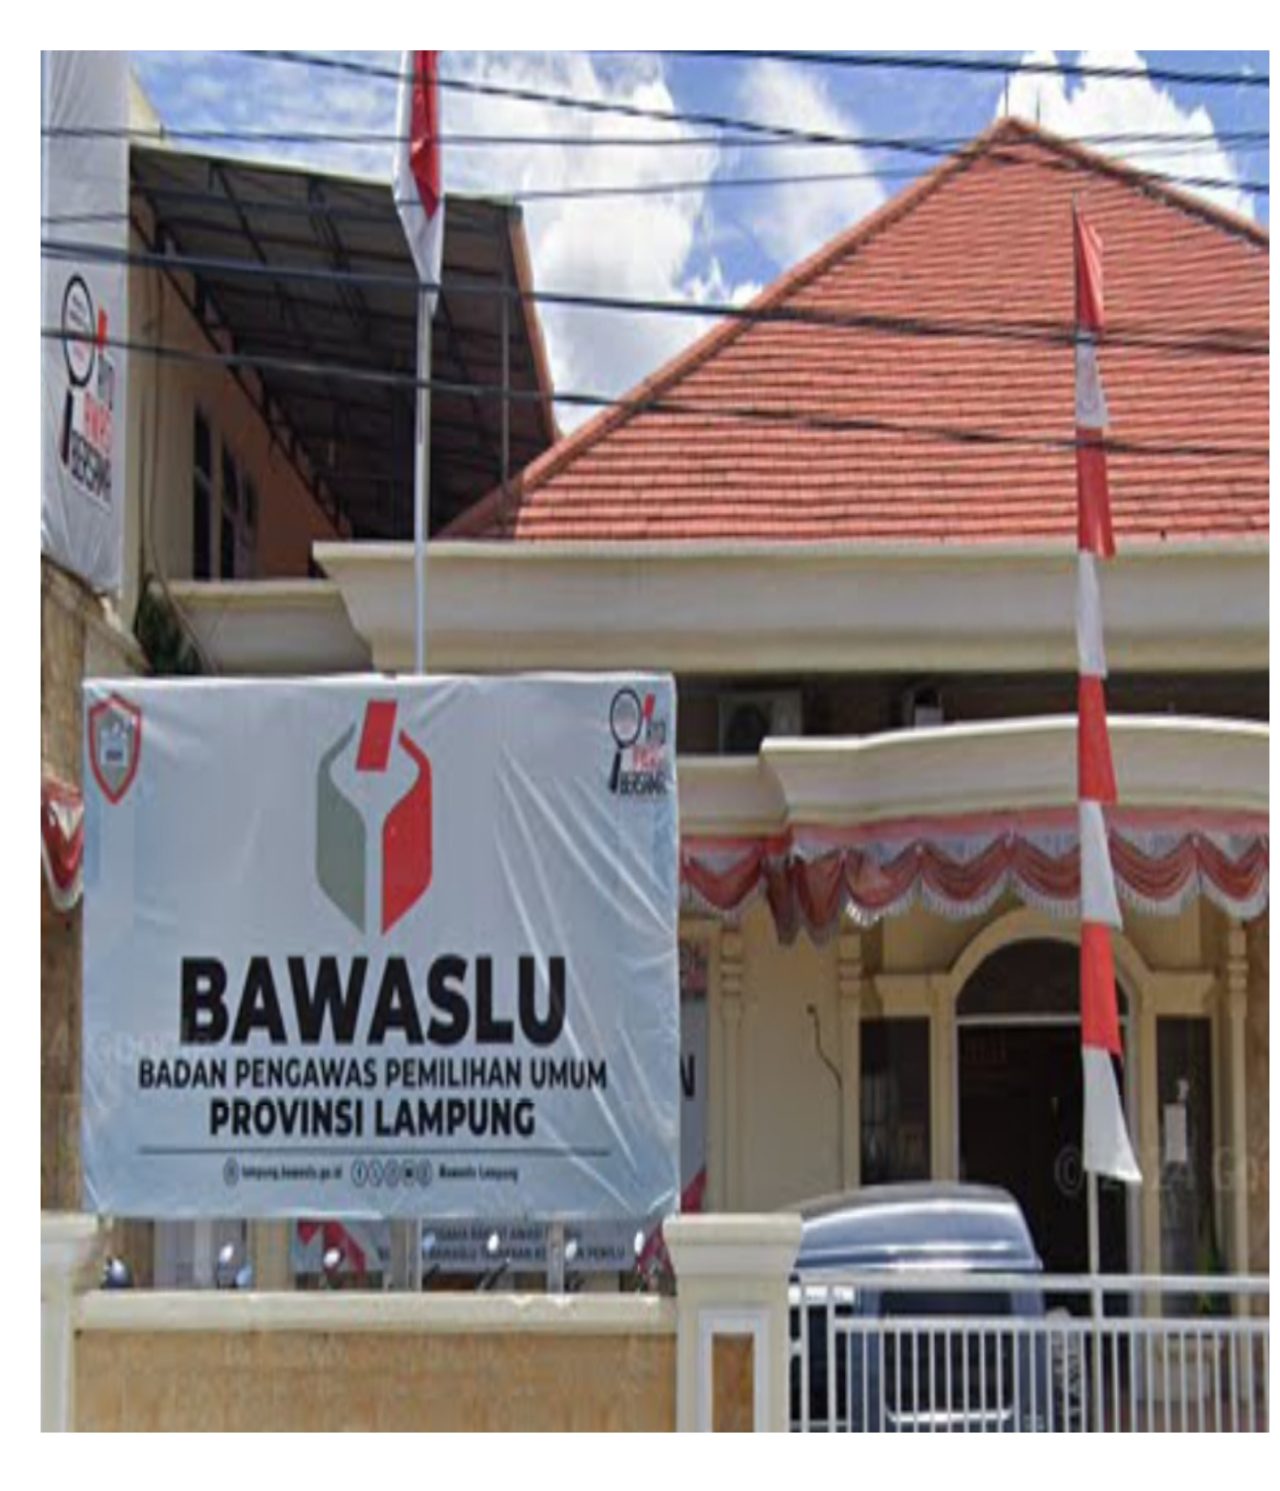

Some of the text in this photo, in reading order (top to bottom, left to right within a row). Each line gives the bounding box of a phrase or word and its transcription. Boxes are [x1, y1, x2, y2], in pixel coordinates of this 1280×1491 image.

[180, 954, 566, 1047] BAWASLU
[138, 1057, 608, 1090] BADAN PENGAWAS PEMILIHAN UMUM
[209, 1098, 536, 1138] PROVINSI LAMPUNG
